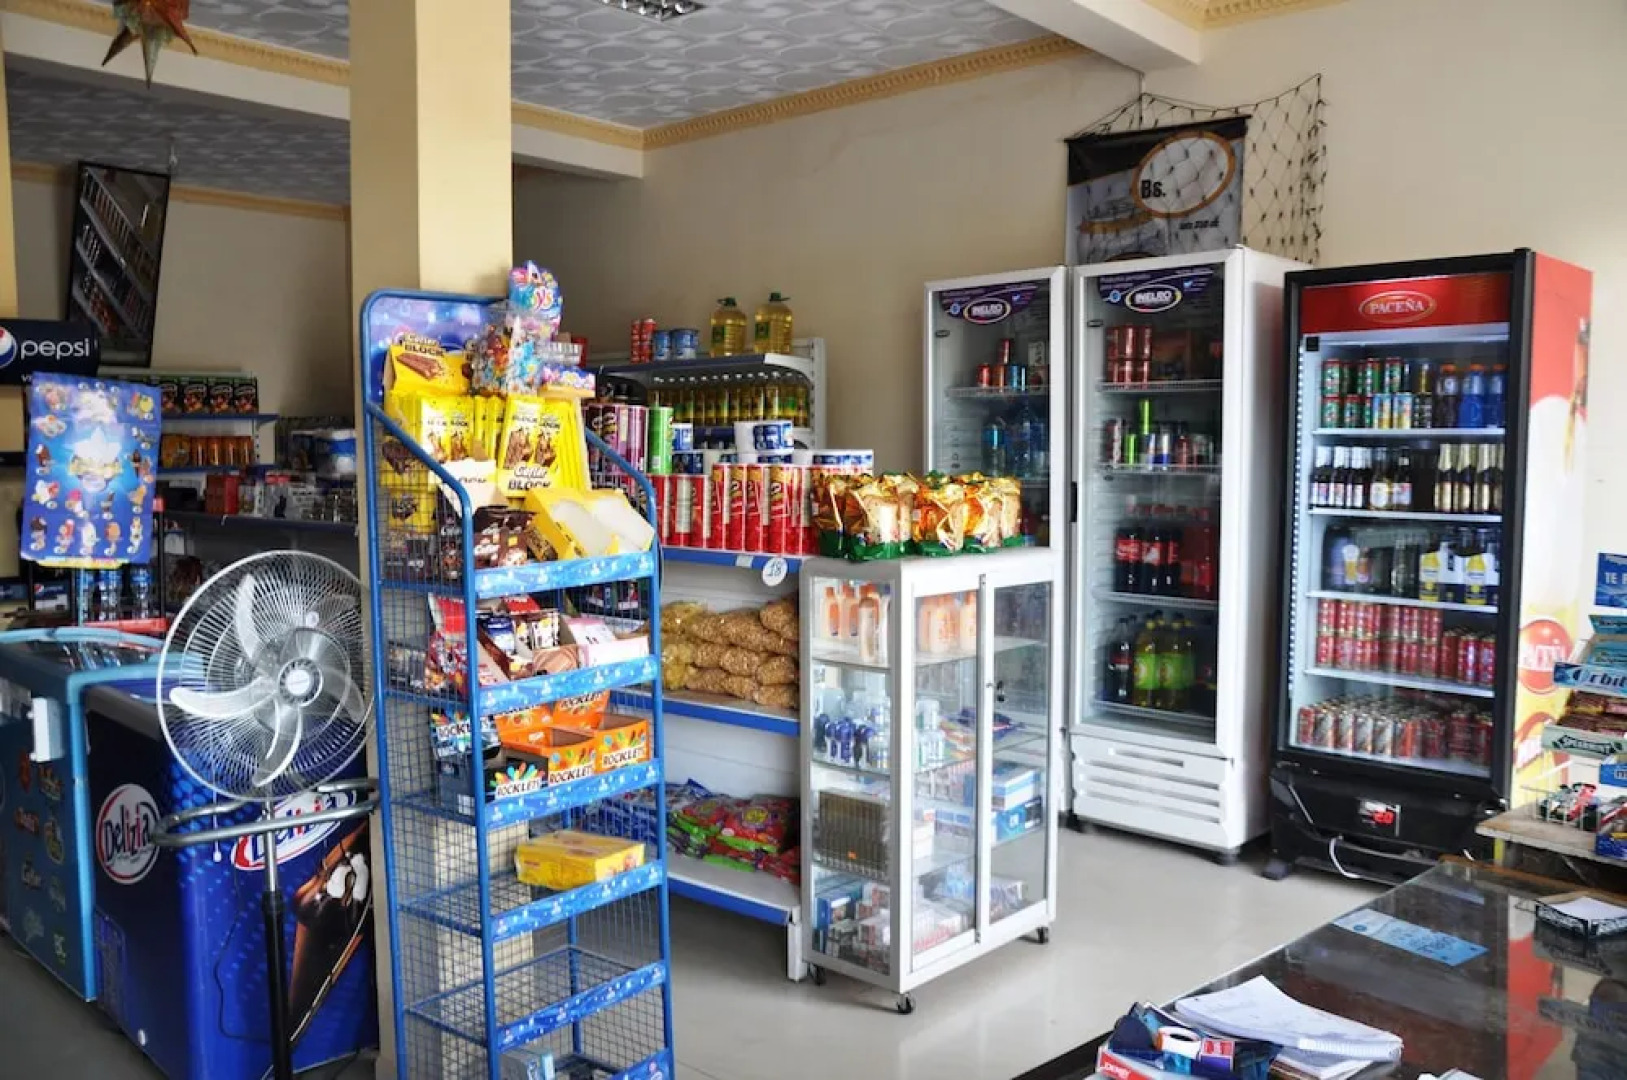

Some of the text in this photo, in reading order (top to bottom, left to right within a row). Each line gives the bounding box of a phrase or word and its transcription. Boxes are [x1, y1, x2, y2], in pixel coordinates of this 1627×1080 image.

[1141, 179, 1166, 199] Bs.
[1368, 298, 1424, 315] PACEÑA
[20, 337, 90, 360] pepsi
[1573, 668, 1627, 687] Orbit
[104, 804, 152, 861] Delizia
